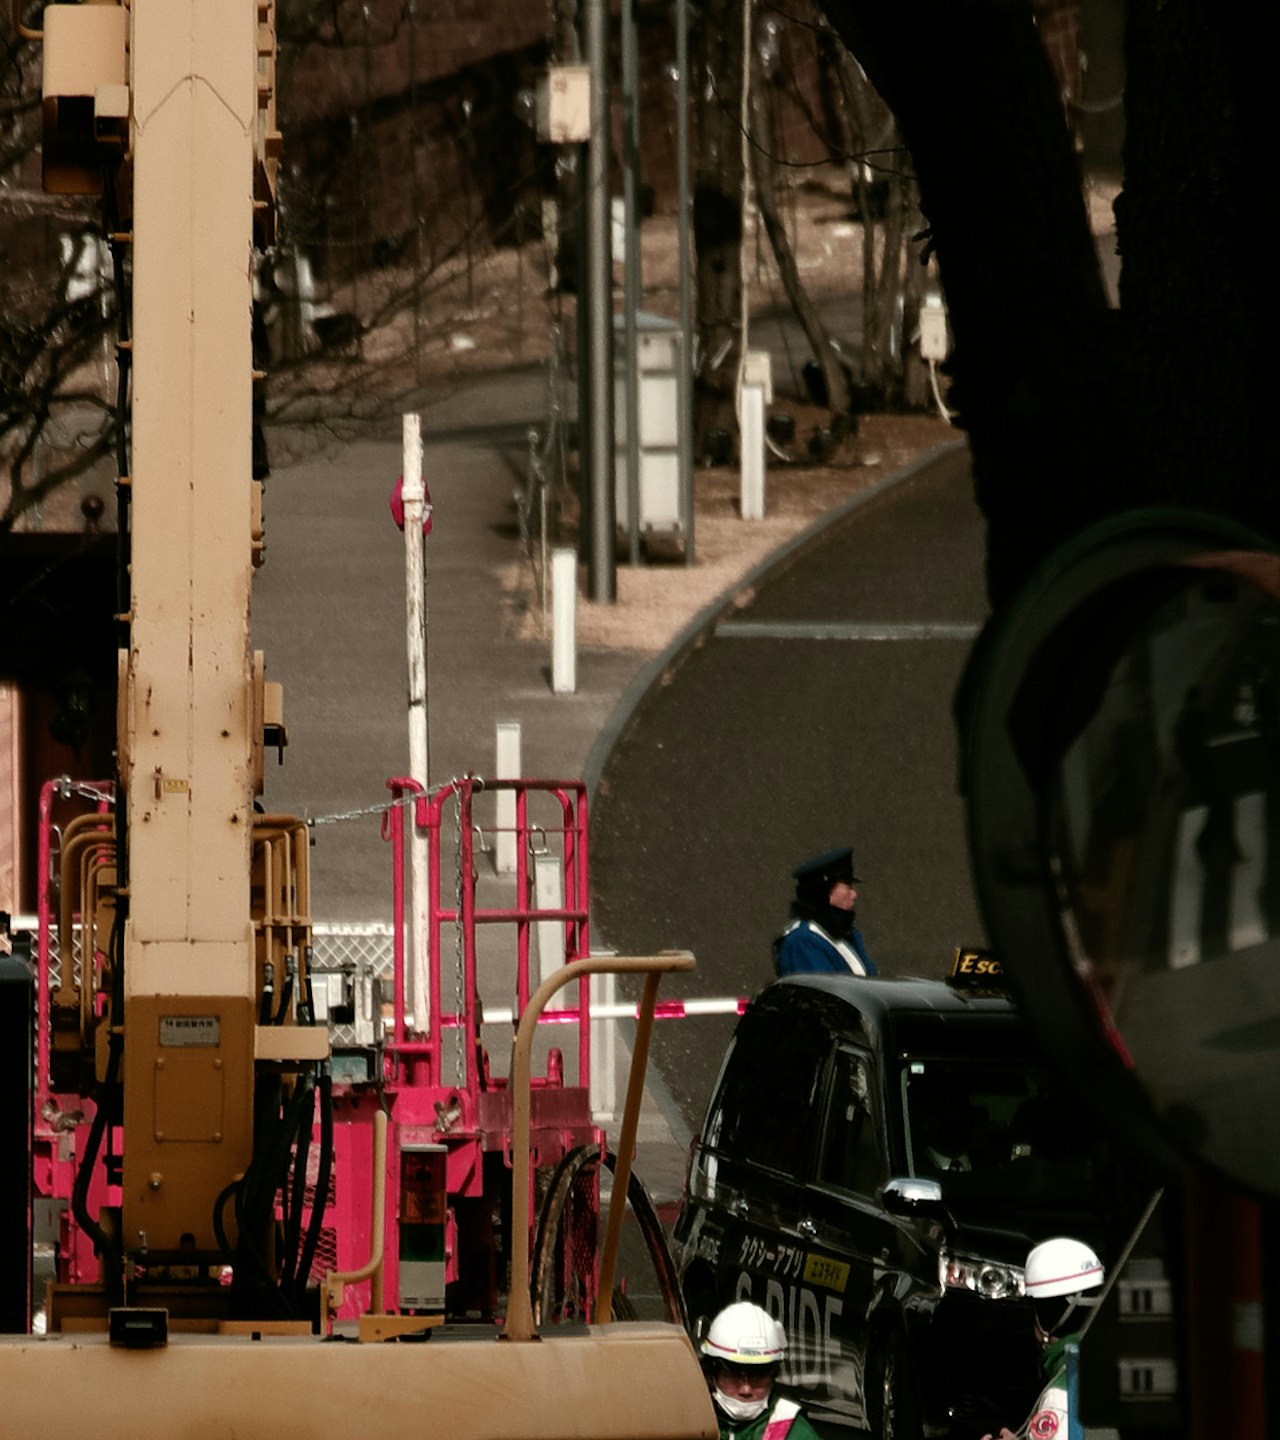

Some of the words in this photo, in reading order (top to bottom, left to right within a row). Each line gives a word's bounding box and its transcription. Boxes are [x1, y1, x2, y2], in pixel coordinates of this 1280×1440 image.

[959, 954, 1004, 975] Esc
[739, 1234, 804, 1279] タクシーアプリ
